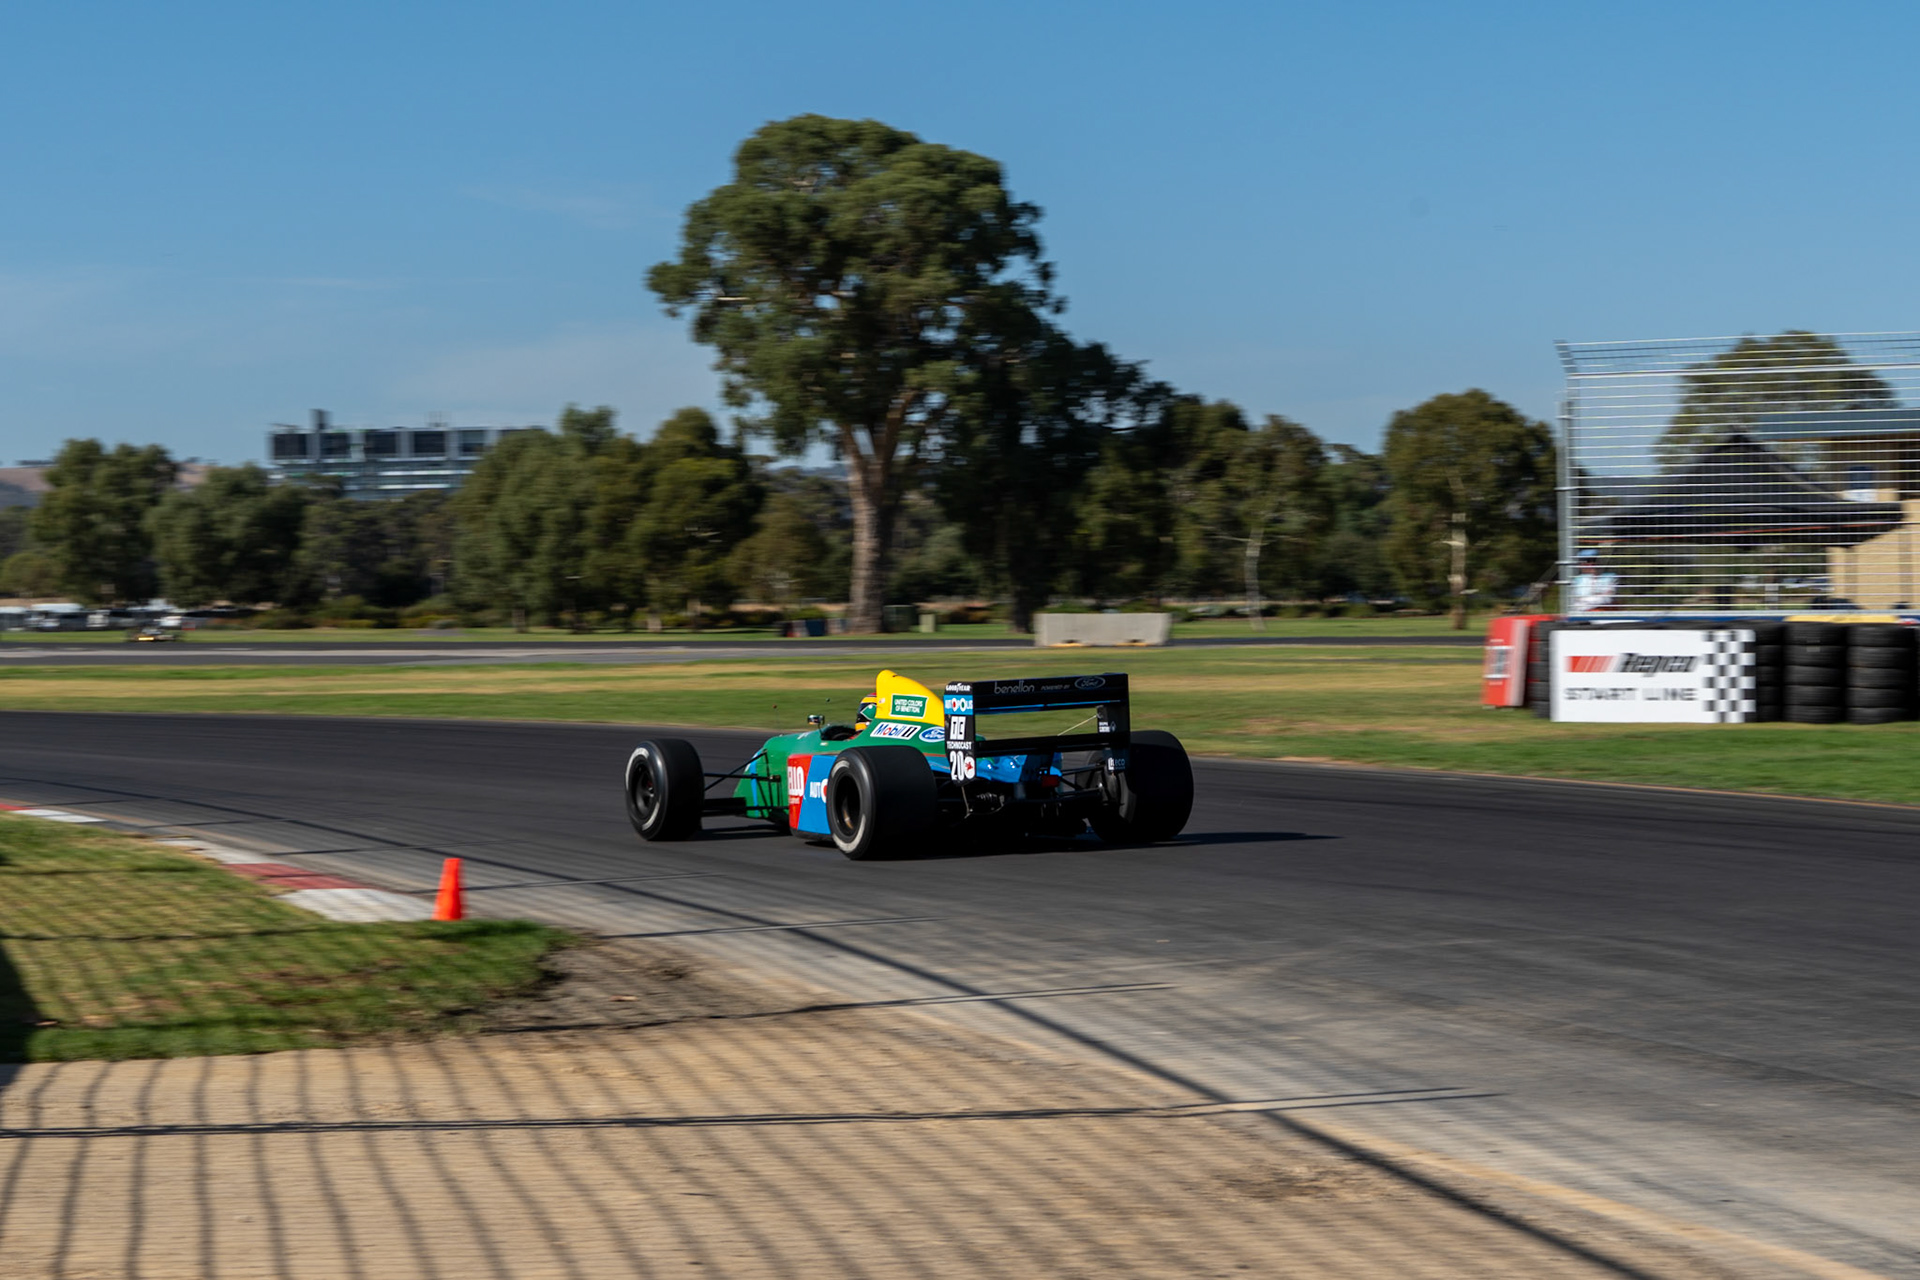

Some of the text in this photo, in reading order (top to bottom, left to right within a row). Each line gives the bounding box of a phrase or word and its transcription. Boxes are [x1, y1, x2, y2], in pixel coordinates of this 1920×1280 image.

[1563, 687, 1698, 701] START LINE
[873, 723, 906, 737] Mobil
[946, 741, 972, 750] TECHNOCAST
